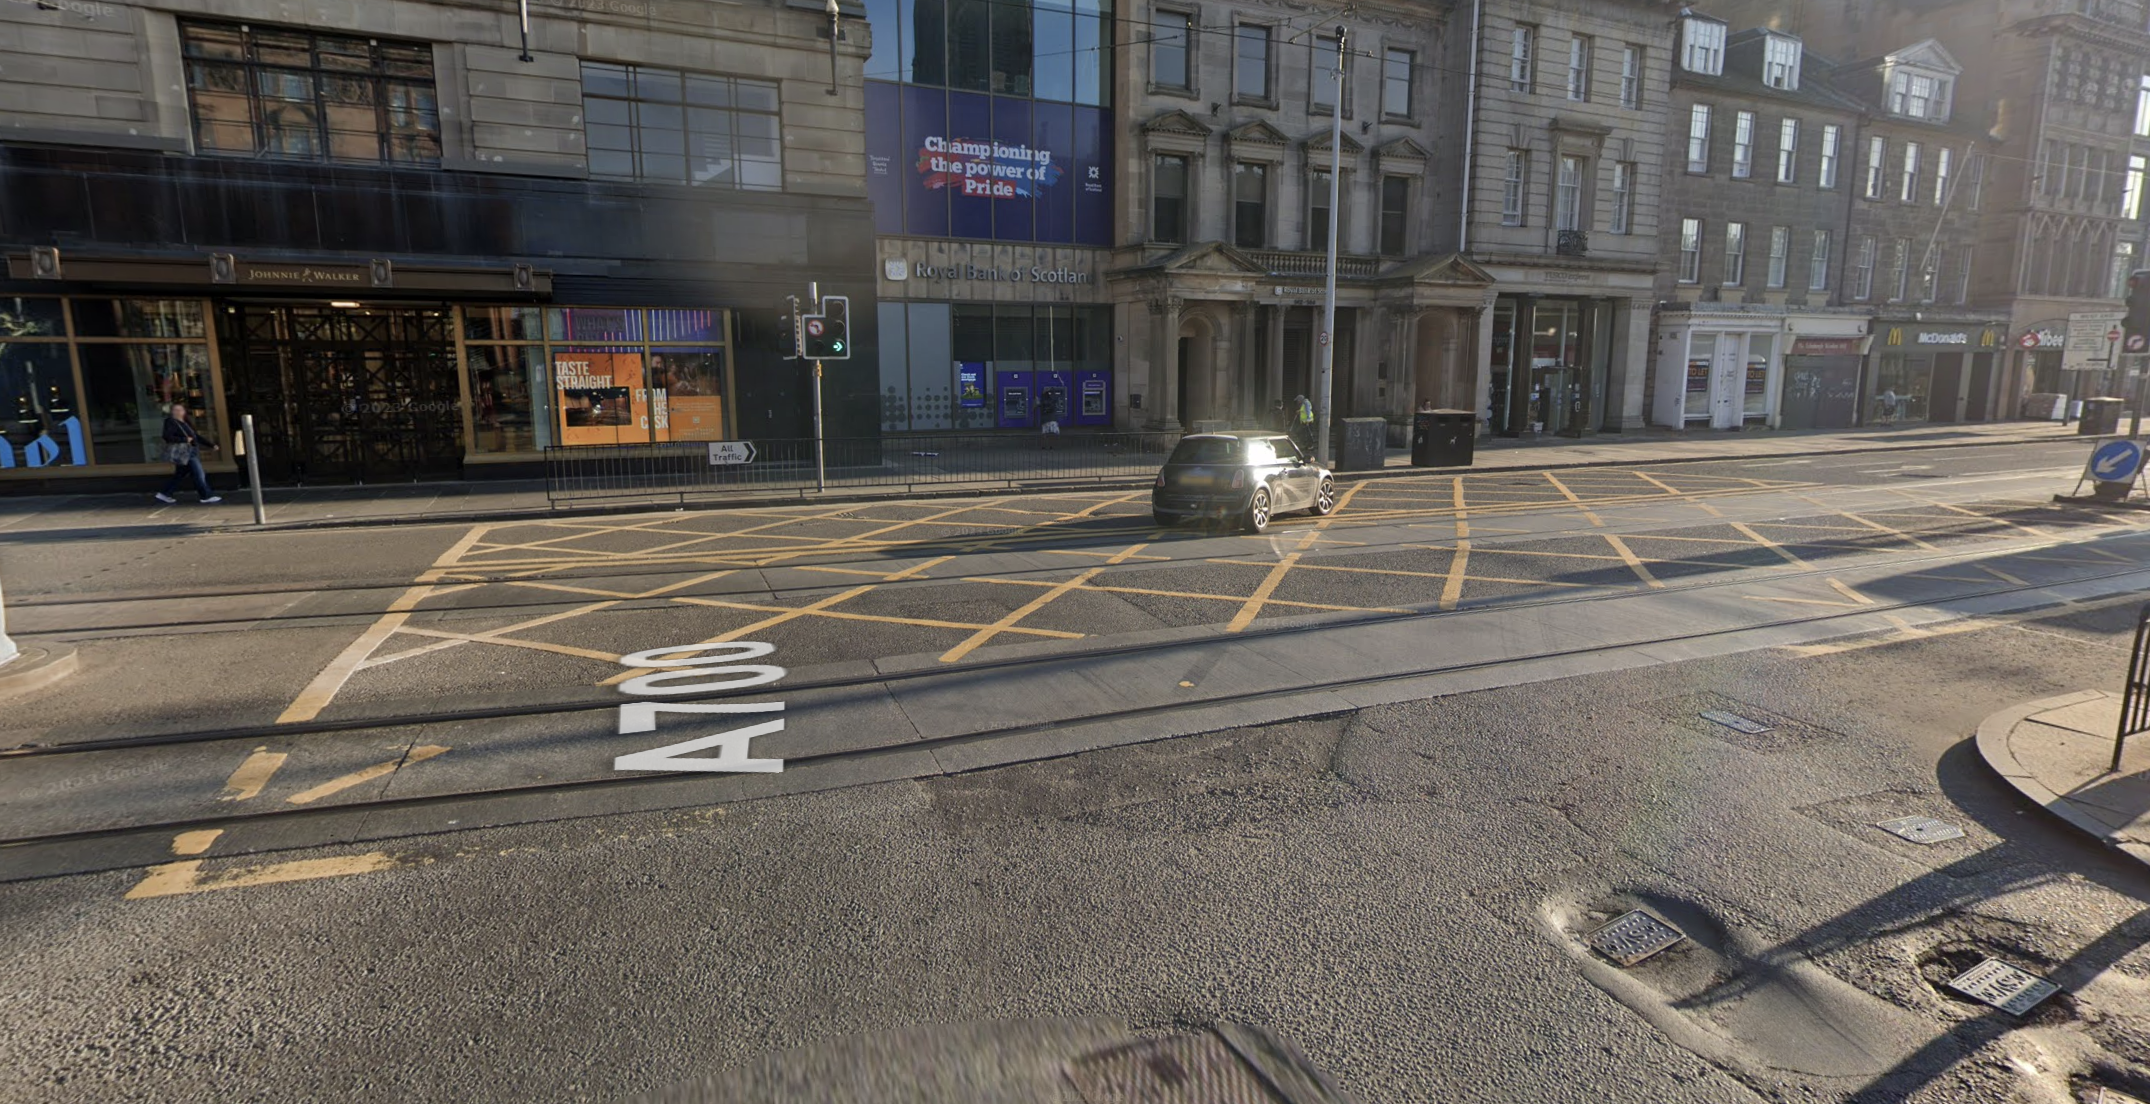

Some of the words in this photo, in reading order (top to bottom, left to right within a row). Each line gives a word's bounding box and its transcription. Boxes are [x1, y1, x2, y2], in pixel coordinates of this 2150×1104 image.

[924, 136, 1051, 165] Championing
[930, 157, 962, 173] the
[965, 162, 1025, 178] power
[1026, 166, 1046, 180] of
[965, 179, 1013, 196] Pride
[248, 269, 300, 280] JOHNNIE
[314, 271, 360, 281] WALKER
[916, 261, 963, 284] Royal
[966, 264, 1005, 281] Bank
[1009, 265, 1027, 281] of
[1918, 332, 1967, 344] McDonald's
[555, 361, 590, 376] TASTE
[1698, 367, 1709, 376] LET
[556, 375, 612, 390] STRAIGHT
[640, 415, 669, 429] CSK
[713, 453, 742, 461] Traffic
